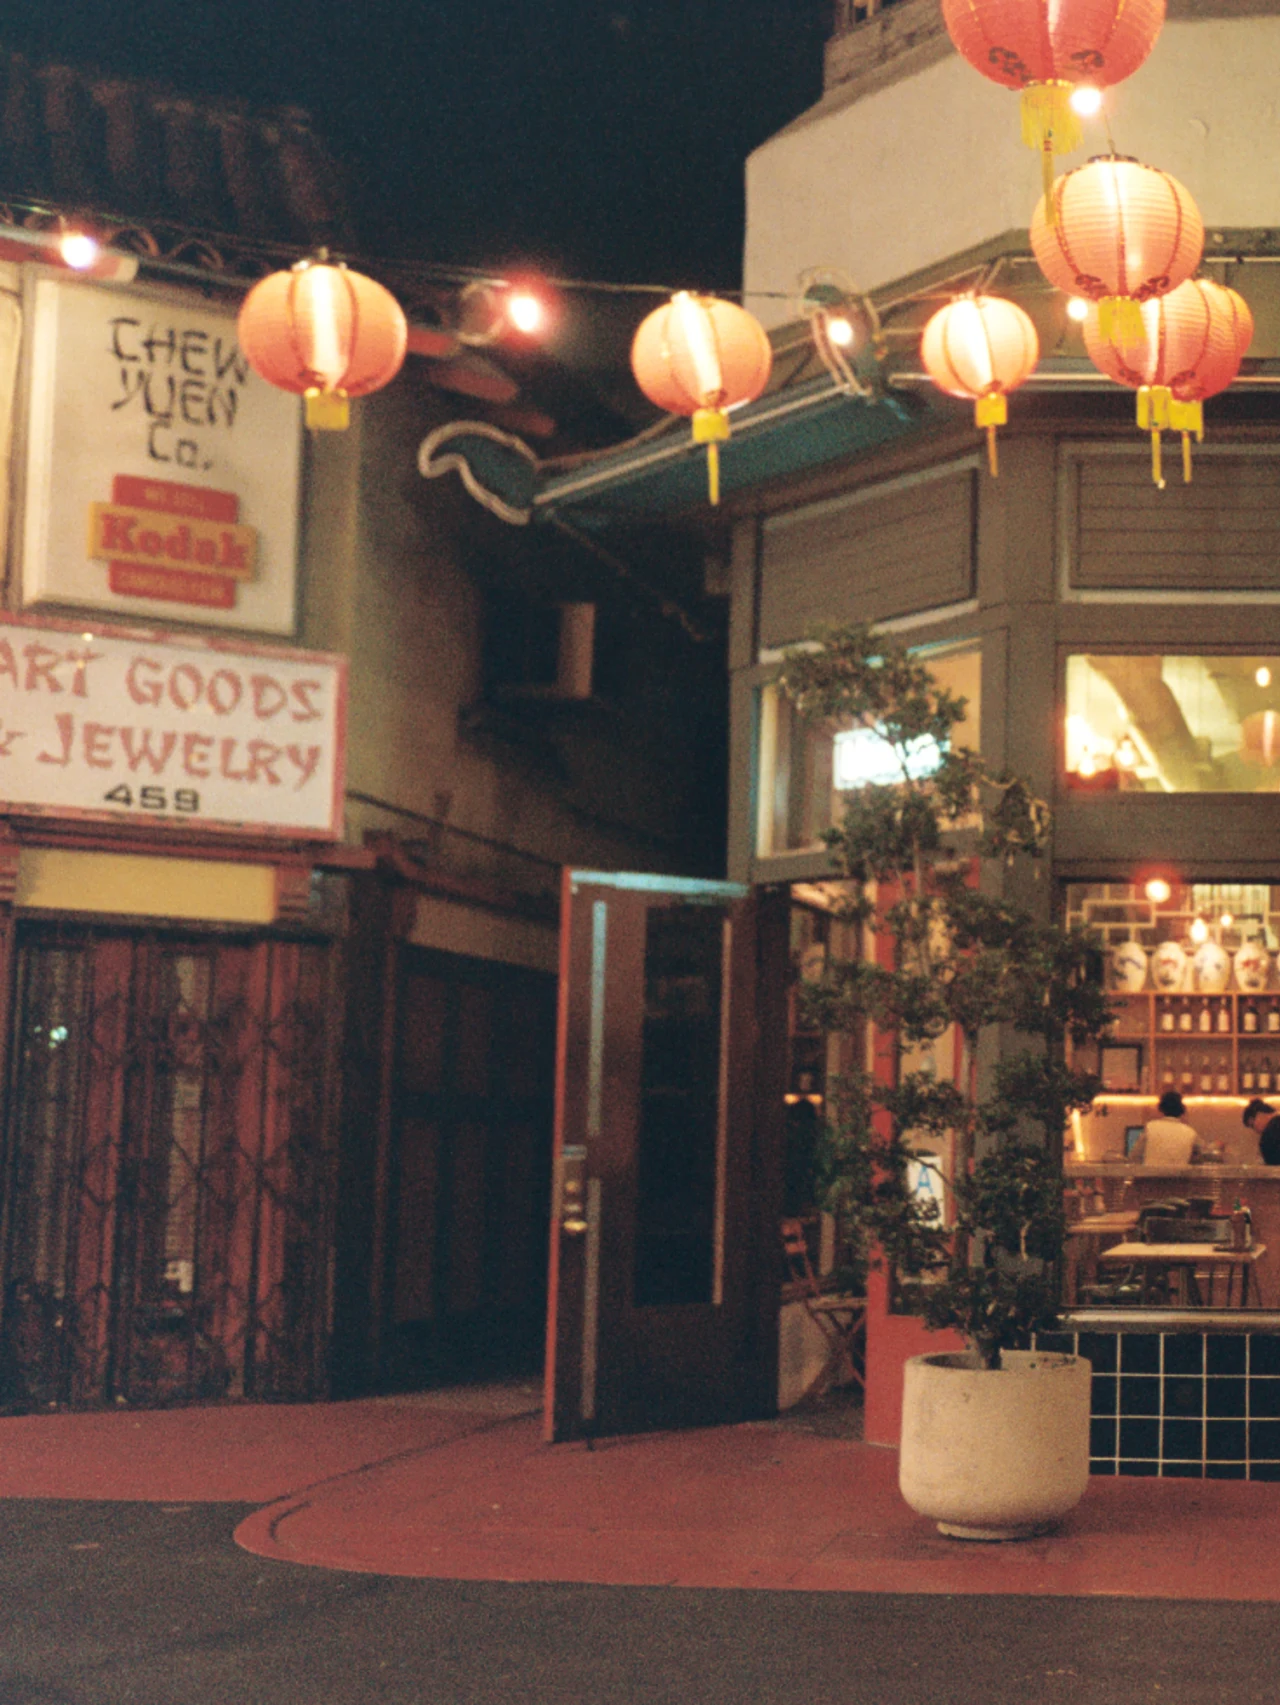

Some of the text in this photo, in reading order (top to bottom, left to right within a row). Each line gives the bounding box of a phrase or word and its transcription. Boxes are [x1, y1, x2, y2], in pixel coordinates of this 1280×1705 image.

[109, 316, 248, 384] CHEW
[111, 367, 237, 428] YUEN
[101, 514, 247, 570] Kodak
[125, 656, 323, 723] GOODS
[36, 712, 321, 791] JEWELRY
[104, 783, 200, 813] 459
[915, 1165, 934, 1197] A
